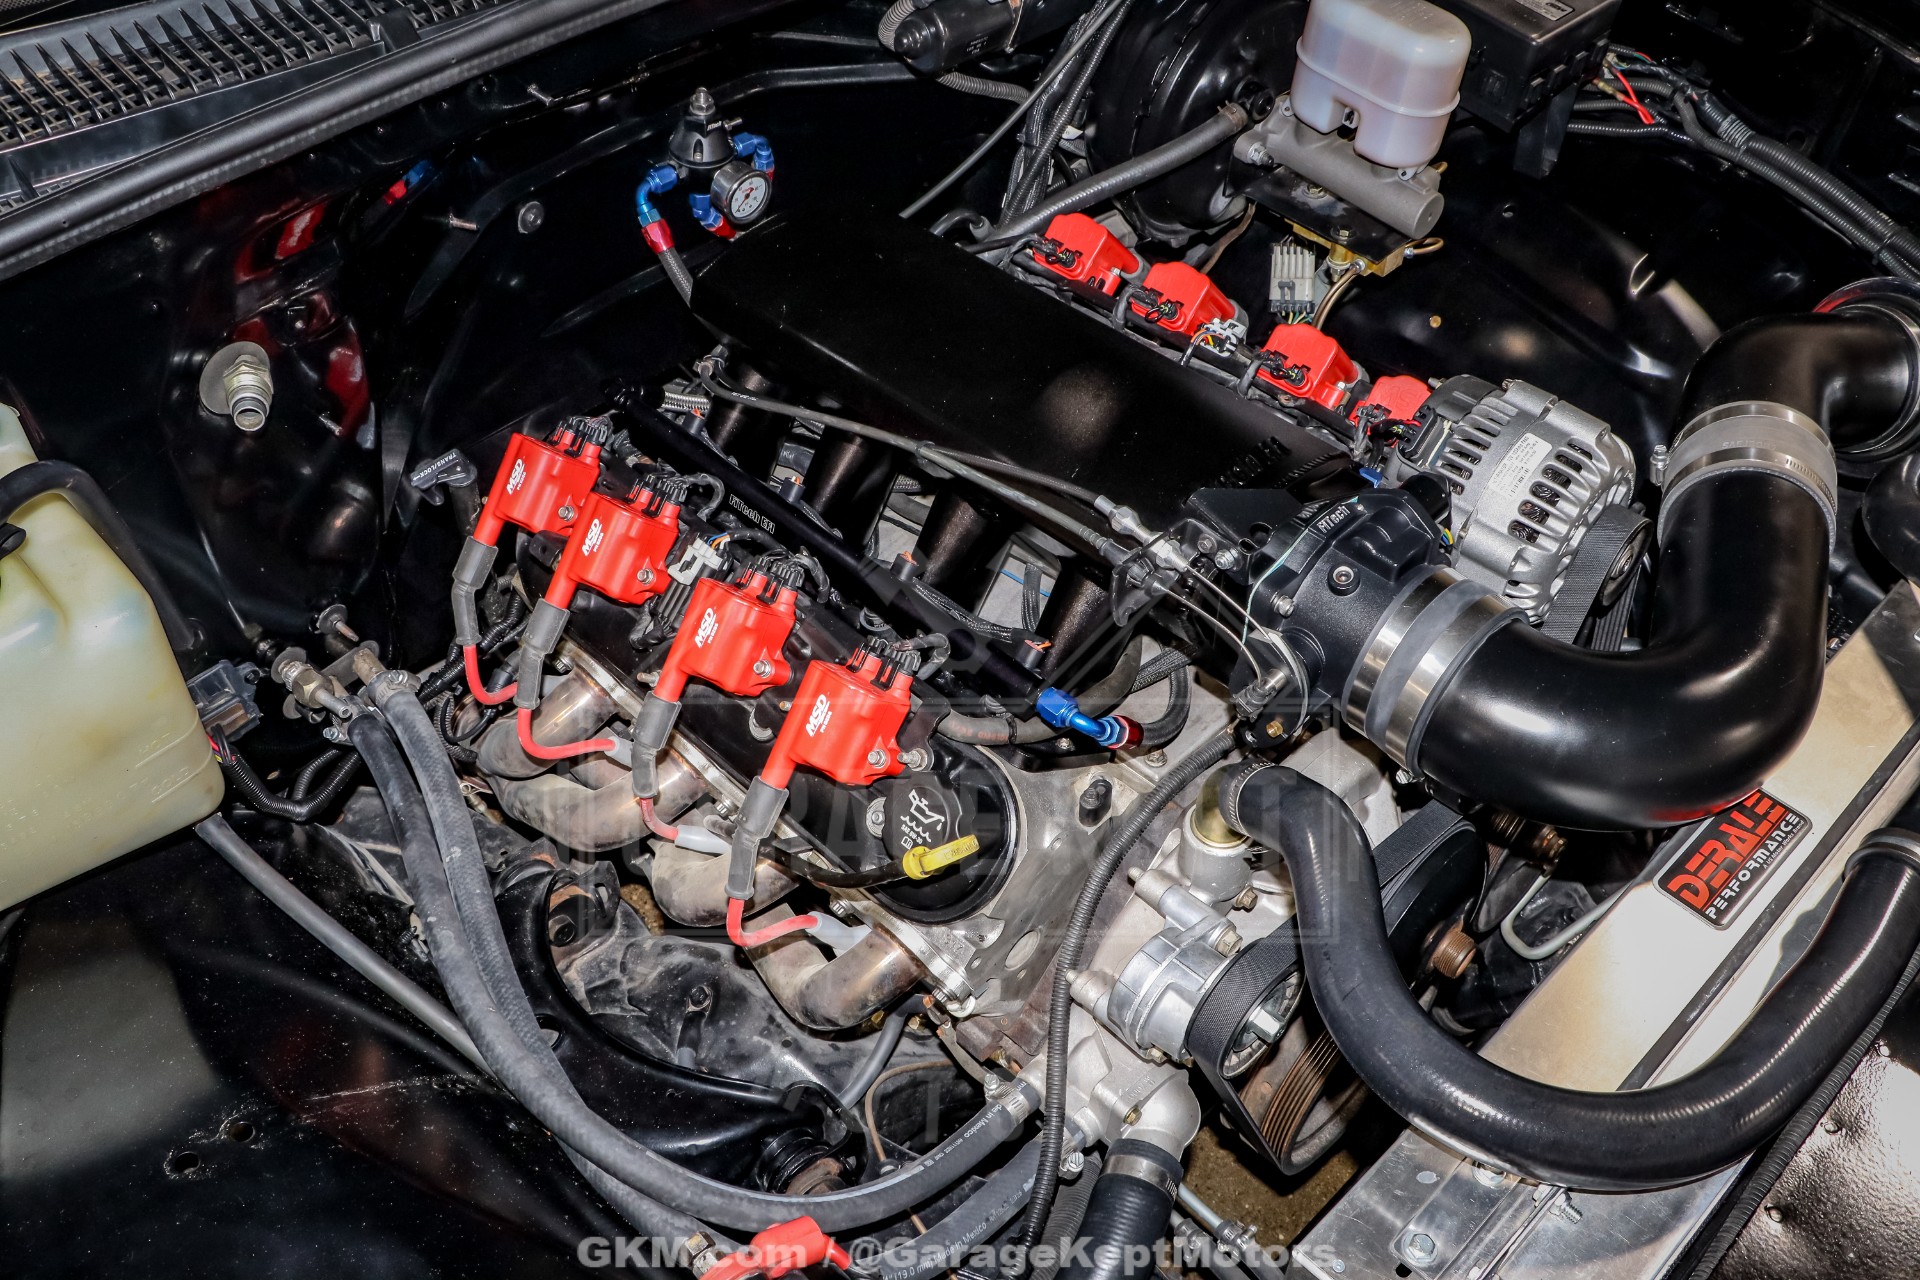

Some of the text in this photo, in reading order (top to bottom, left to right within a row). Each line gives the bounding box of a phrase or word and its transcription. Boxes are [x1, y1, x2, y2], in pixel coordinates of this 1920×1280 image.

[419, 452, 457, 478] TRANS/LOCK
[506, 459, 524, 495] MSD
[581, 518, 601, 556] MSD
[760, 515, 776, 535] EFI
[694, 607, 716, 648] MSD
[805, 694, 829, 737] MSD
[1666, 792, 1786, 910] DERALE
[1771, 845, 1784, 861] Motor
[1781, 834, 1794, 848] Works
[1704, 812, 1800, 920] PERFORMANCE
[963, 1117, 990, 1139] Mexico
[962, 1222, 988, 1244] Mexico
